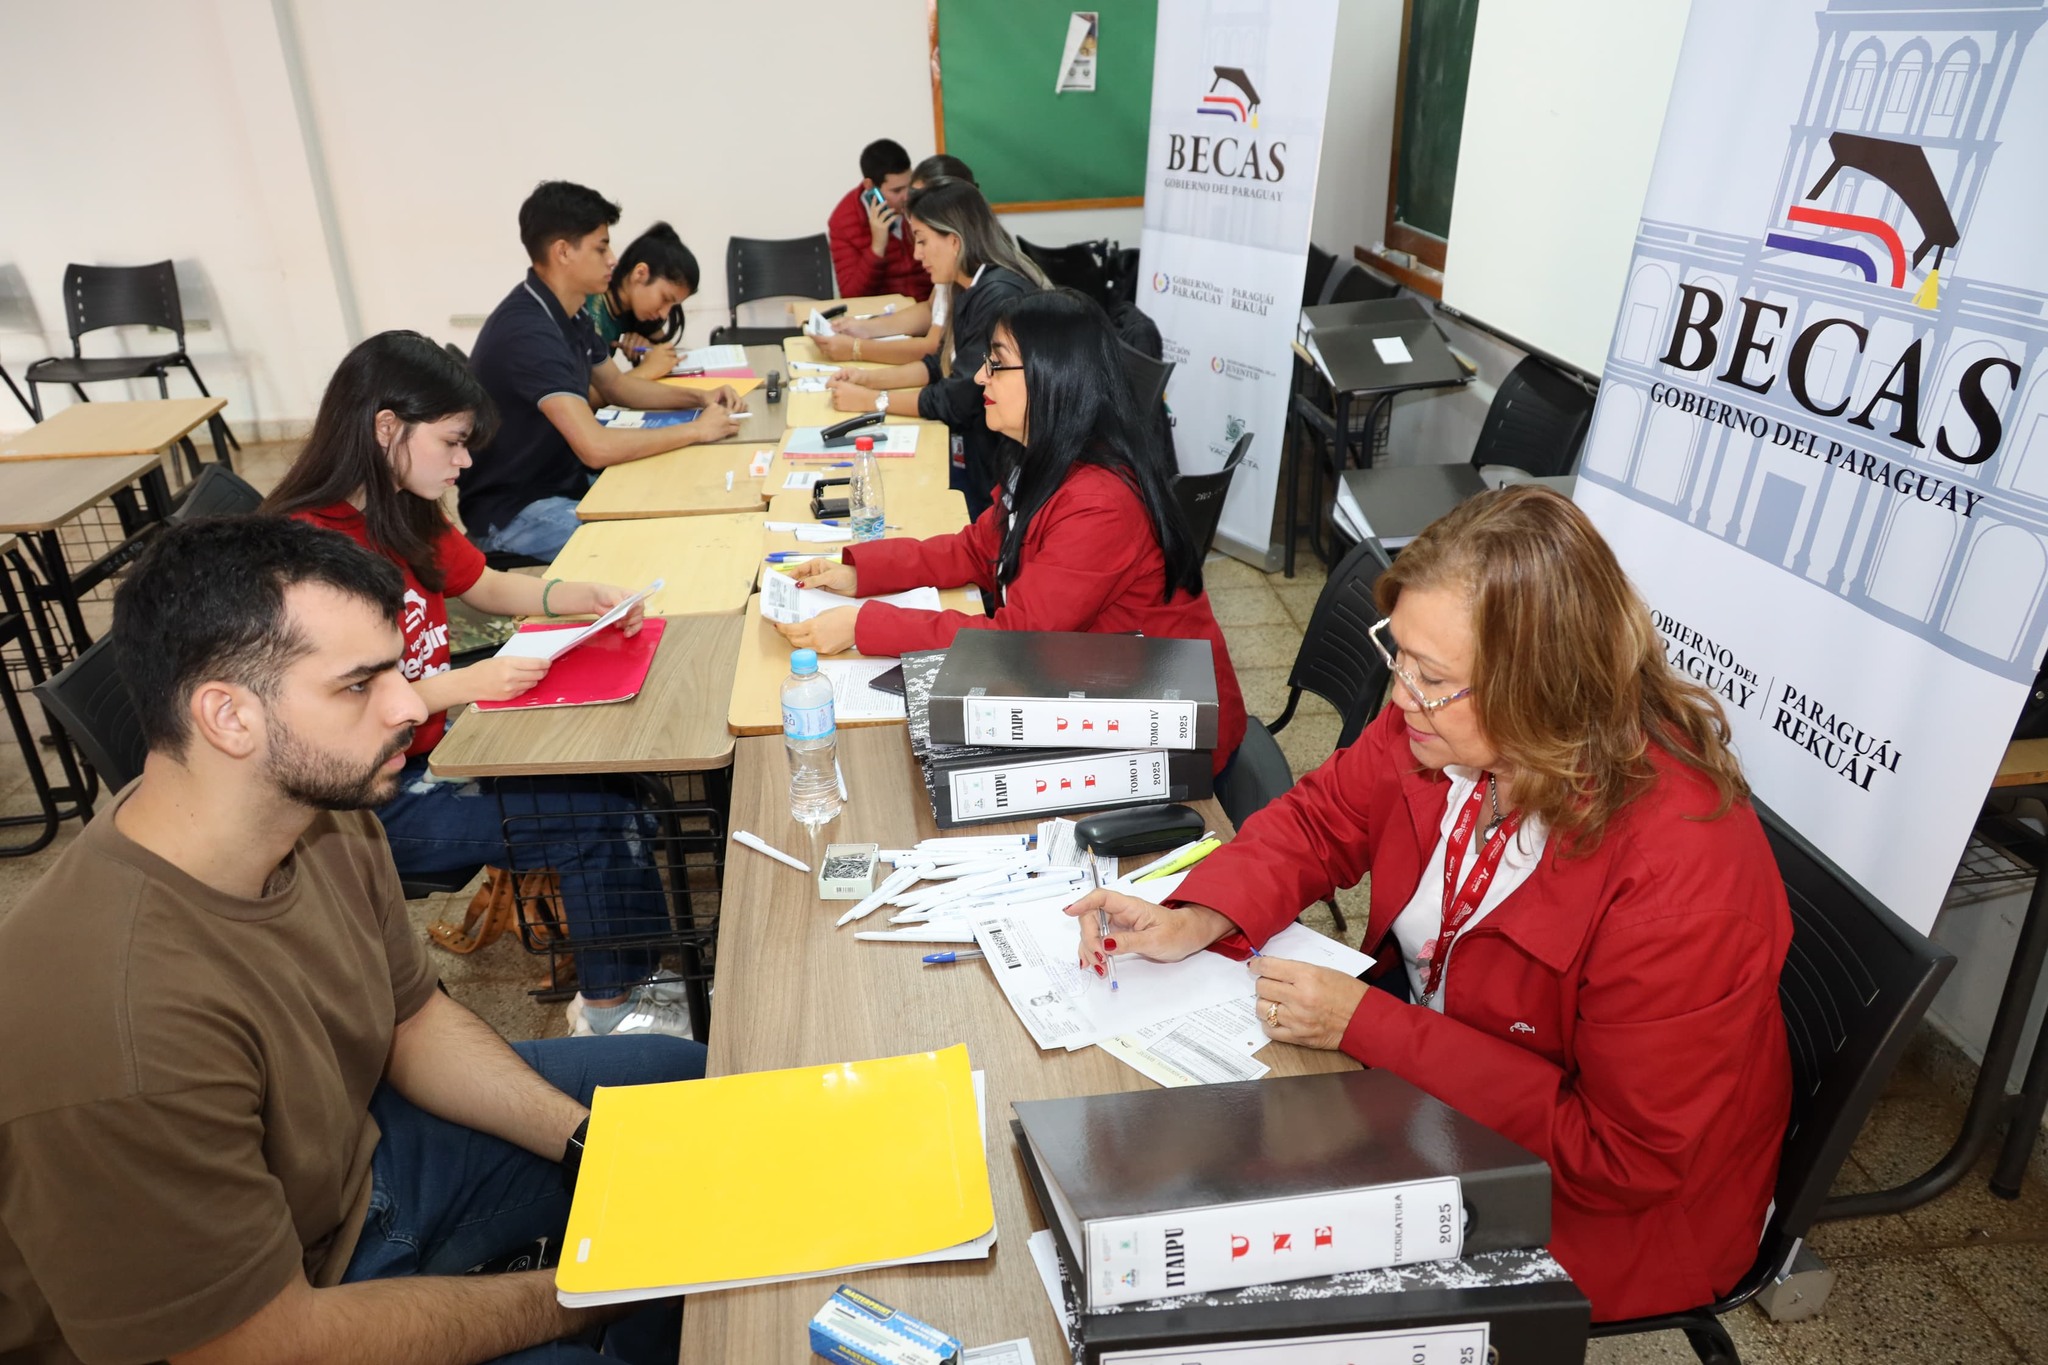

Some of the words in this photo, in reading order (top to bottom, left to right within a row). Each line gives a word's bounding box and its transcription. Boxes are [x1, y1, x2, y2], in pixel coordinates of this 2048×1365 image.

[1166, 133, 1286, 183] BECAS
[1164, 178, 1210, 192] GOBIERNO
[1211, 183, 1230, 194] DEL
[1231, 186, 1283, 202] PARAGUAY
[1172, 275, 1213, 290] GOBIERNO
[1172, 285, 1224, 305] PARAGUAY
[1231, 287, 1274, 306] PARAGUÁI
[1659, 282, 2021, 464] BECAS
[1650, 382, 1769, 439] GOBIERNO
[1771, 421, 1820, 459] DEL
[1824, 440, 1985, 519] PARAGUAY
[1649, 608, 1734, 668] OBIERNO
[1734, 663, 1760, 687] DEL
[1660, 637, 1756, 710] RAGUAY
[1011, 708, 1024, 741] ITAIPU
[1056, 716, 1069, 732] U
[1082, 719, 1094, 731] P
[1107, 719, 1119, 733] E
[1150, 709, 1159, 720] IV
[1179, 715, 1188, 739] 2025
[1781, 684, 1903, 774] PARAGUÁI
[1150, 722, 1159, 746] TOMO
[1772, 706, 1878, 792] REKUÁI
[1035, 779, 1048, 794] U
[1060, 777, 1072, 790] P
[1084, 774, 1096, 788] E
[1130, 769, 1138, 794] TOMO
[1152, 761, 1161, 785] 2025
[994, 773, 1008, 808] ITAIPU
[1394, 1194, 1403, 1263] TECNICATURA
[1438, 1203, 1452, 1244] 2025
[1165, 1227, 1185, 1288] ITAIPU
[1231, 1233, 1249, 1262] U
[1273, 1231, 1292, 1255] N
[1314, 1225, 1333, 1250] E
[841, 1287, 894, 1316] MASTERPRINT
[1460, 1346, 1474, 1365] 25
